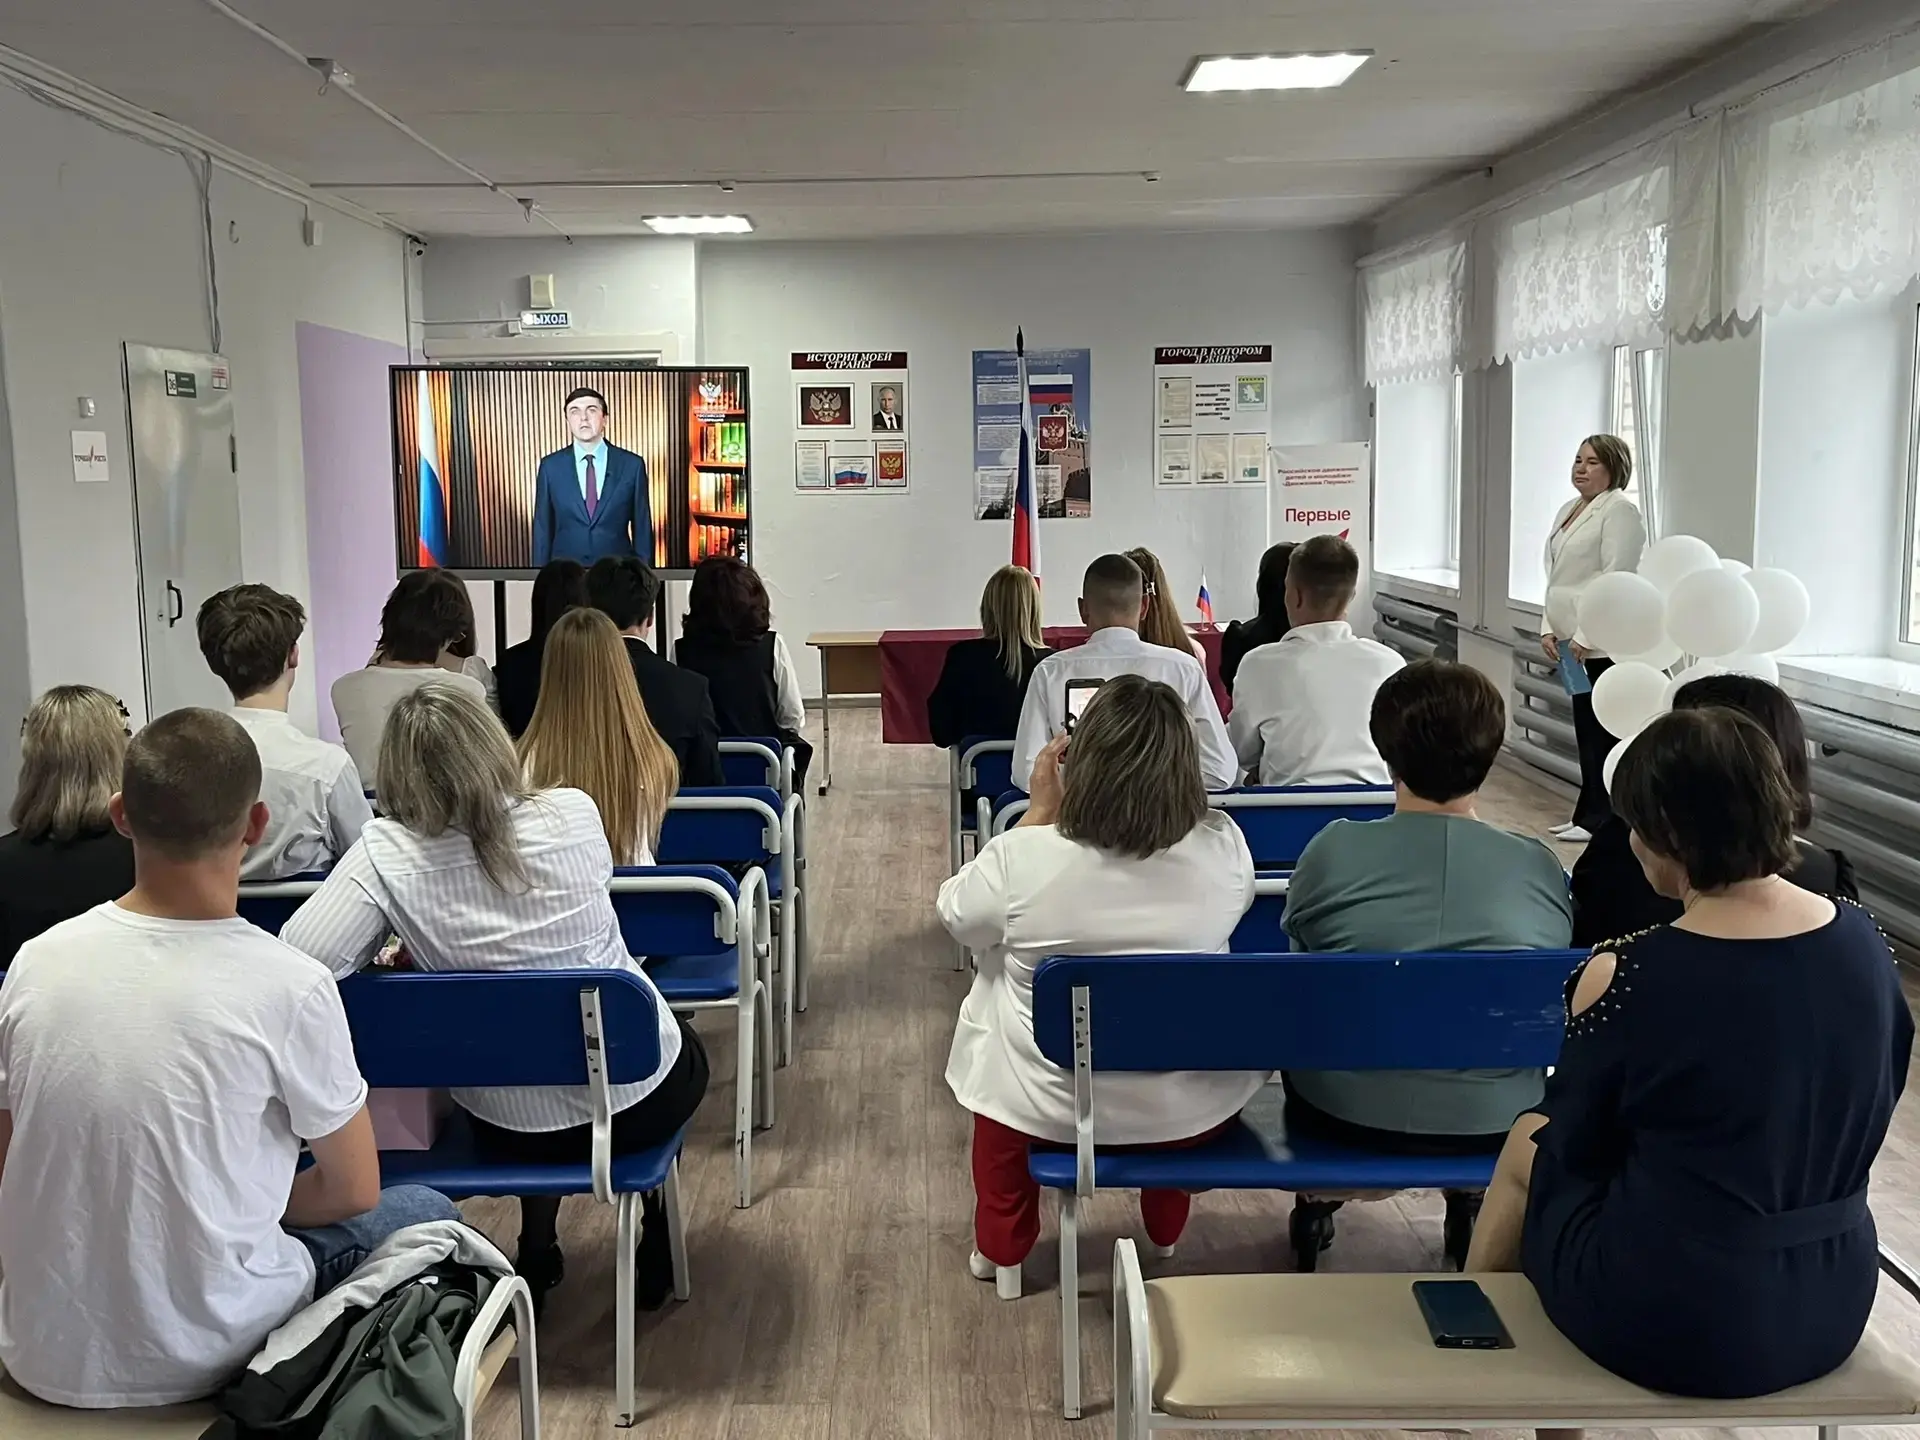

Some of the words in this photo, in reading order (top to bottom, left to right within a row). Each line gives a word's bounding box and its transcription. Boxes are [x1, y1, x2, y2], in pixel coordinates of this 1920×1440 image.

[523, 313, 566, 325] ЫХОД
[1162, 348, 1197, 357] ГОРОД
[1201, 348, 1209, 356] В
[1210, 346, 1263, 356] КОТОРОМ
[806, 353, 859, 362] ИСТОРИЯ
[860, 352, 892, 361] МОЕЙ
[1194, 356, 1202, 364] Я
[1205, 355, 1239, 363] ЖИВУ
[825, 361, 872, 369] СТРАНЫ
[1285, 508, 1351, 526] Первые
